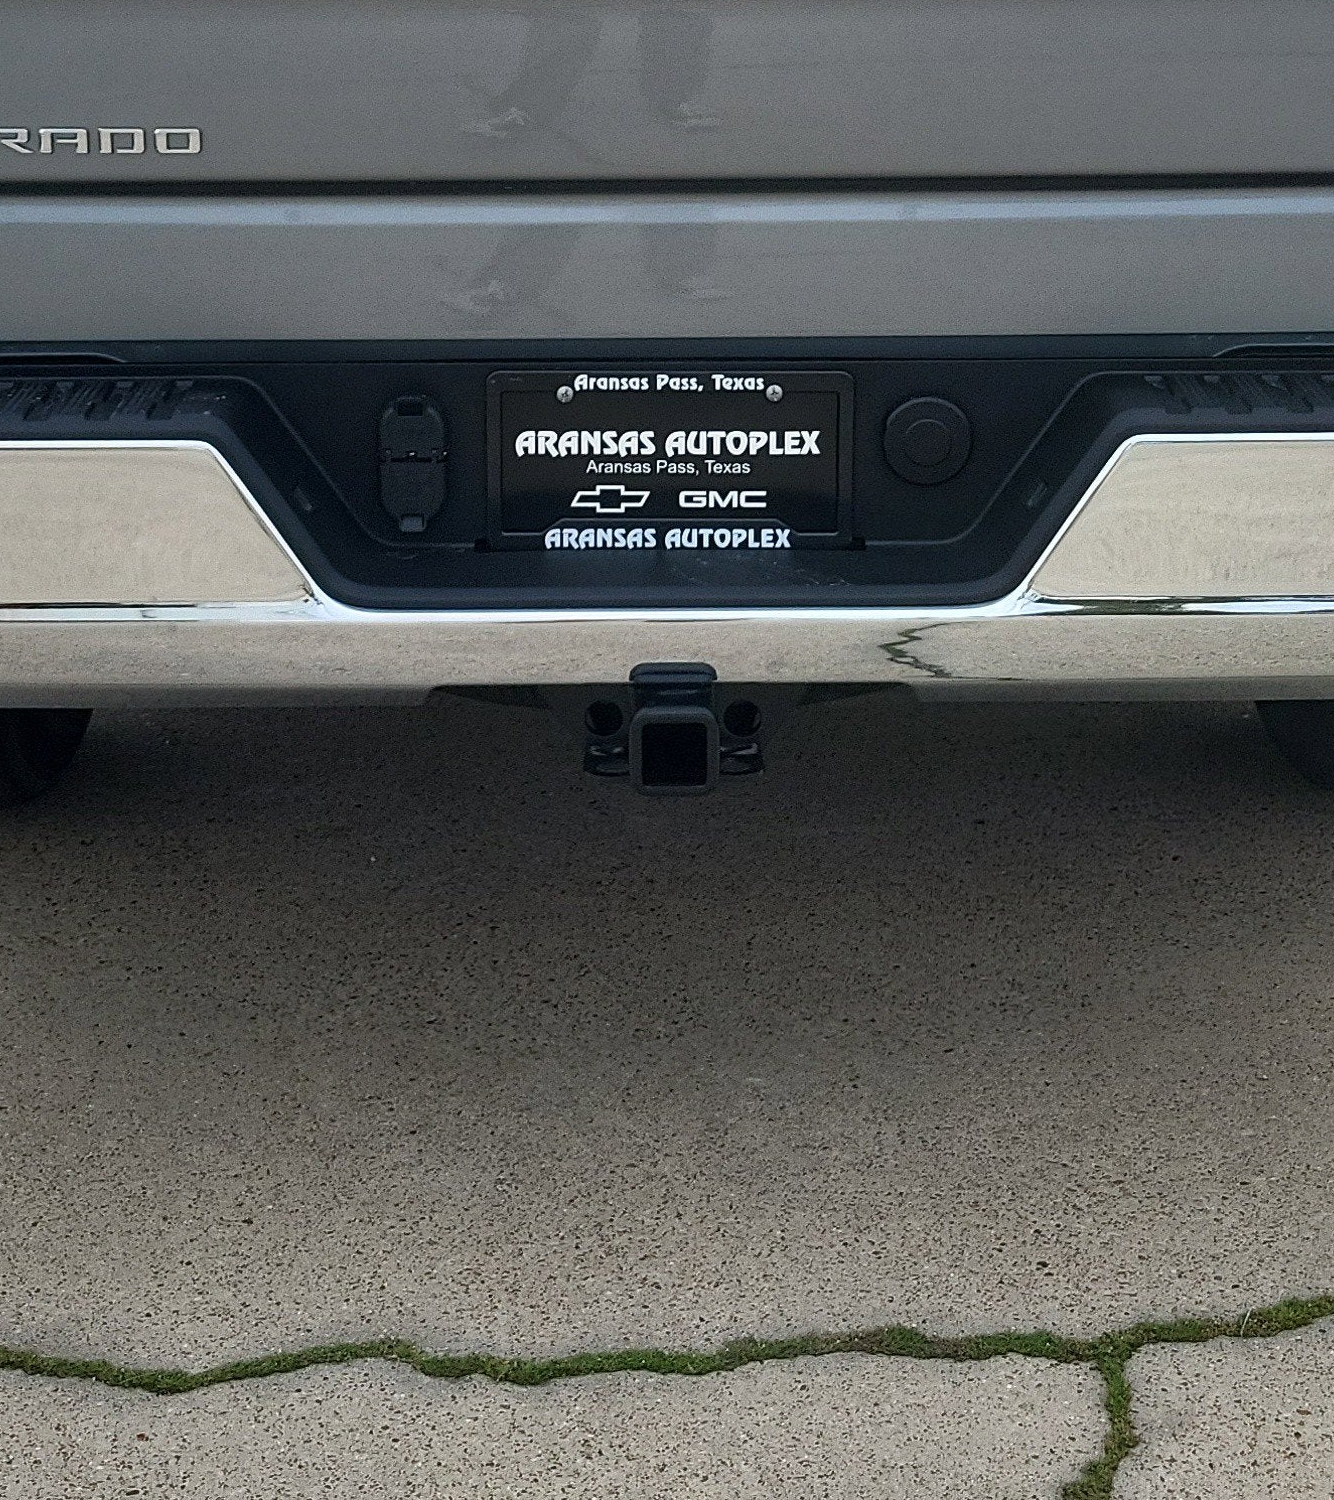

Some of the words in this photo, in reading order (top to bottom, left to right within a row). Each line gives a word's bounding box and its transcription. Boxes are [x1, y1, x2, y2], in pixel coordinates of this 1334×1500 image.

[574, 373, 650, 392] Aransas
[656, 373, 704, 392] Pass,
[711, 373, 765, 391] Texas
[514, 430, 656, 458] ARANSAS
[664, 430, 821, 458] AUTOPLEX
[585, 459, 652, 475] Aransas
[656, 459, 700, 476] Pass,
[704, 459, 751, 475] Texas
[678, 490, 767, 508] GMC
[544, 528, 657, 550] ARANSAS
[664, 528, 791, 550] AUTOPLEX
